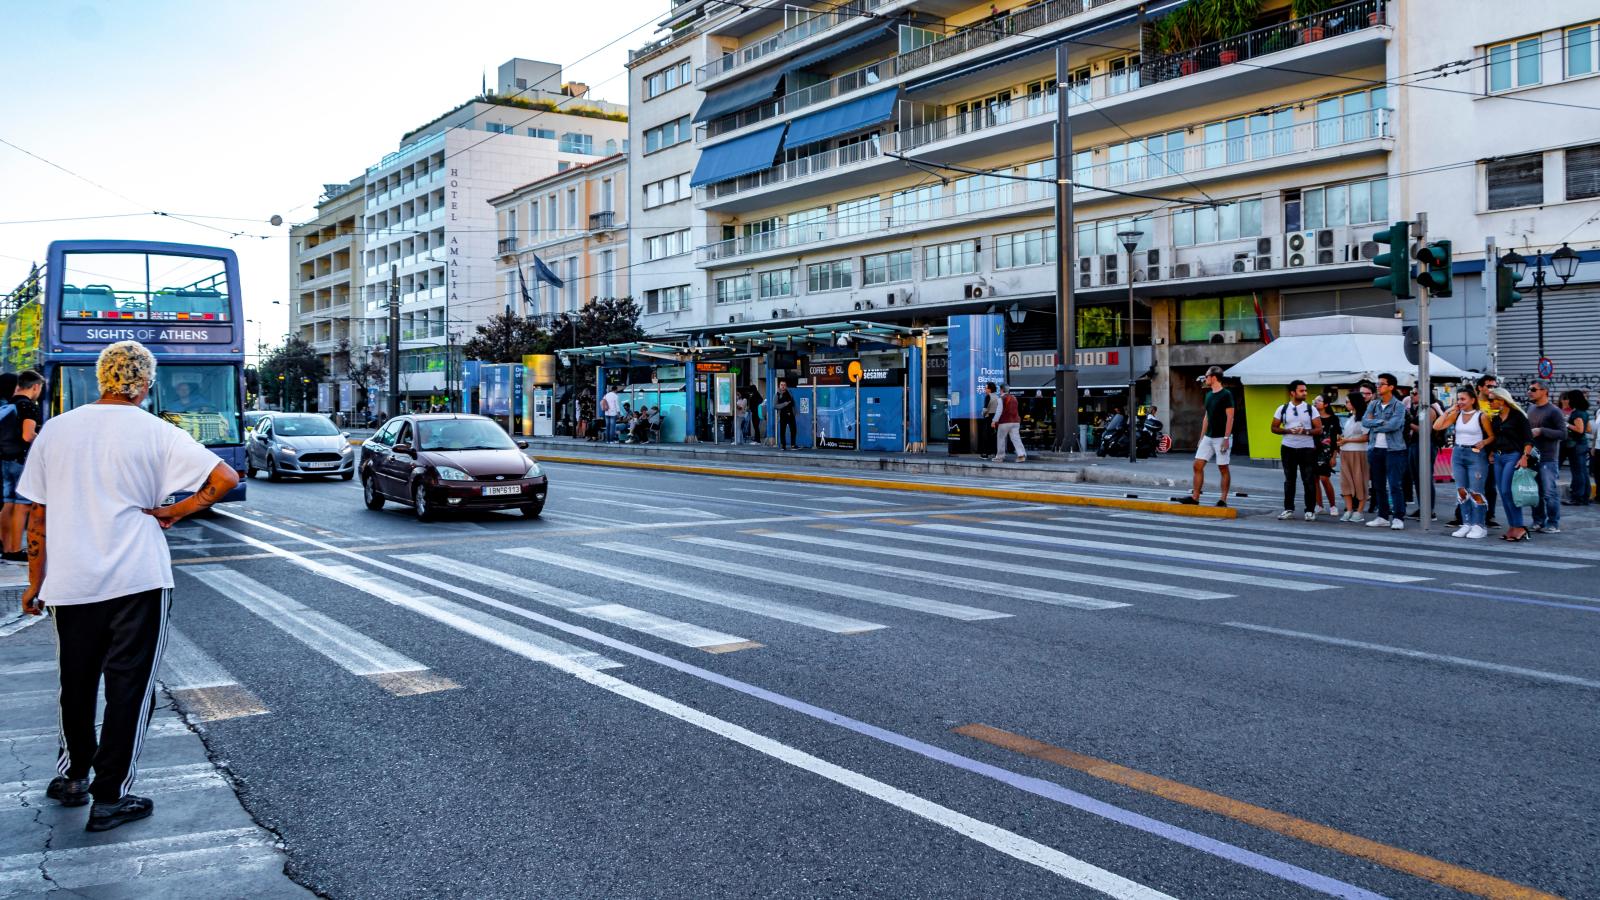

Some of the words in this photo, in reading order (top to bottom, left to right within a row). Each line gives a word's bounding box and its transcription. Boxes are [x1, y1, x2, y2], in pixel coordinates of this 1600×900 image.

[450, 168, 459, 221] HOTEL
[450, 236, 459, 300] AMALIA
[86, 328, 135, 340] SIGHTS
[136, 329, 156, 340] OF
[159, 330, 208, 341] ATHENS
[809, 366, 827, 375] COFFEE
[863, 372, 887, 380] sesame
